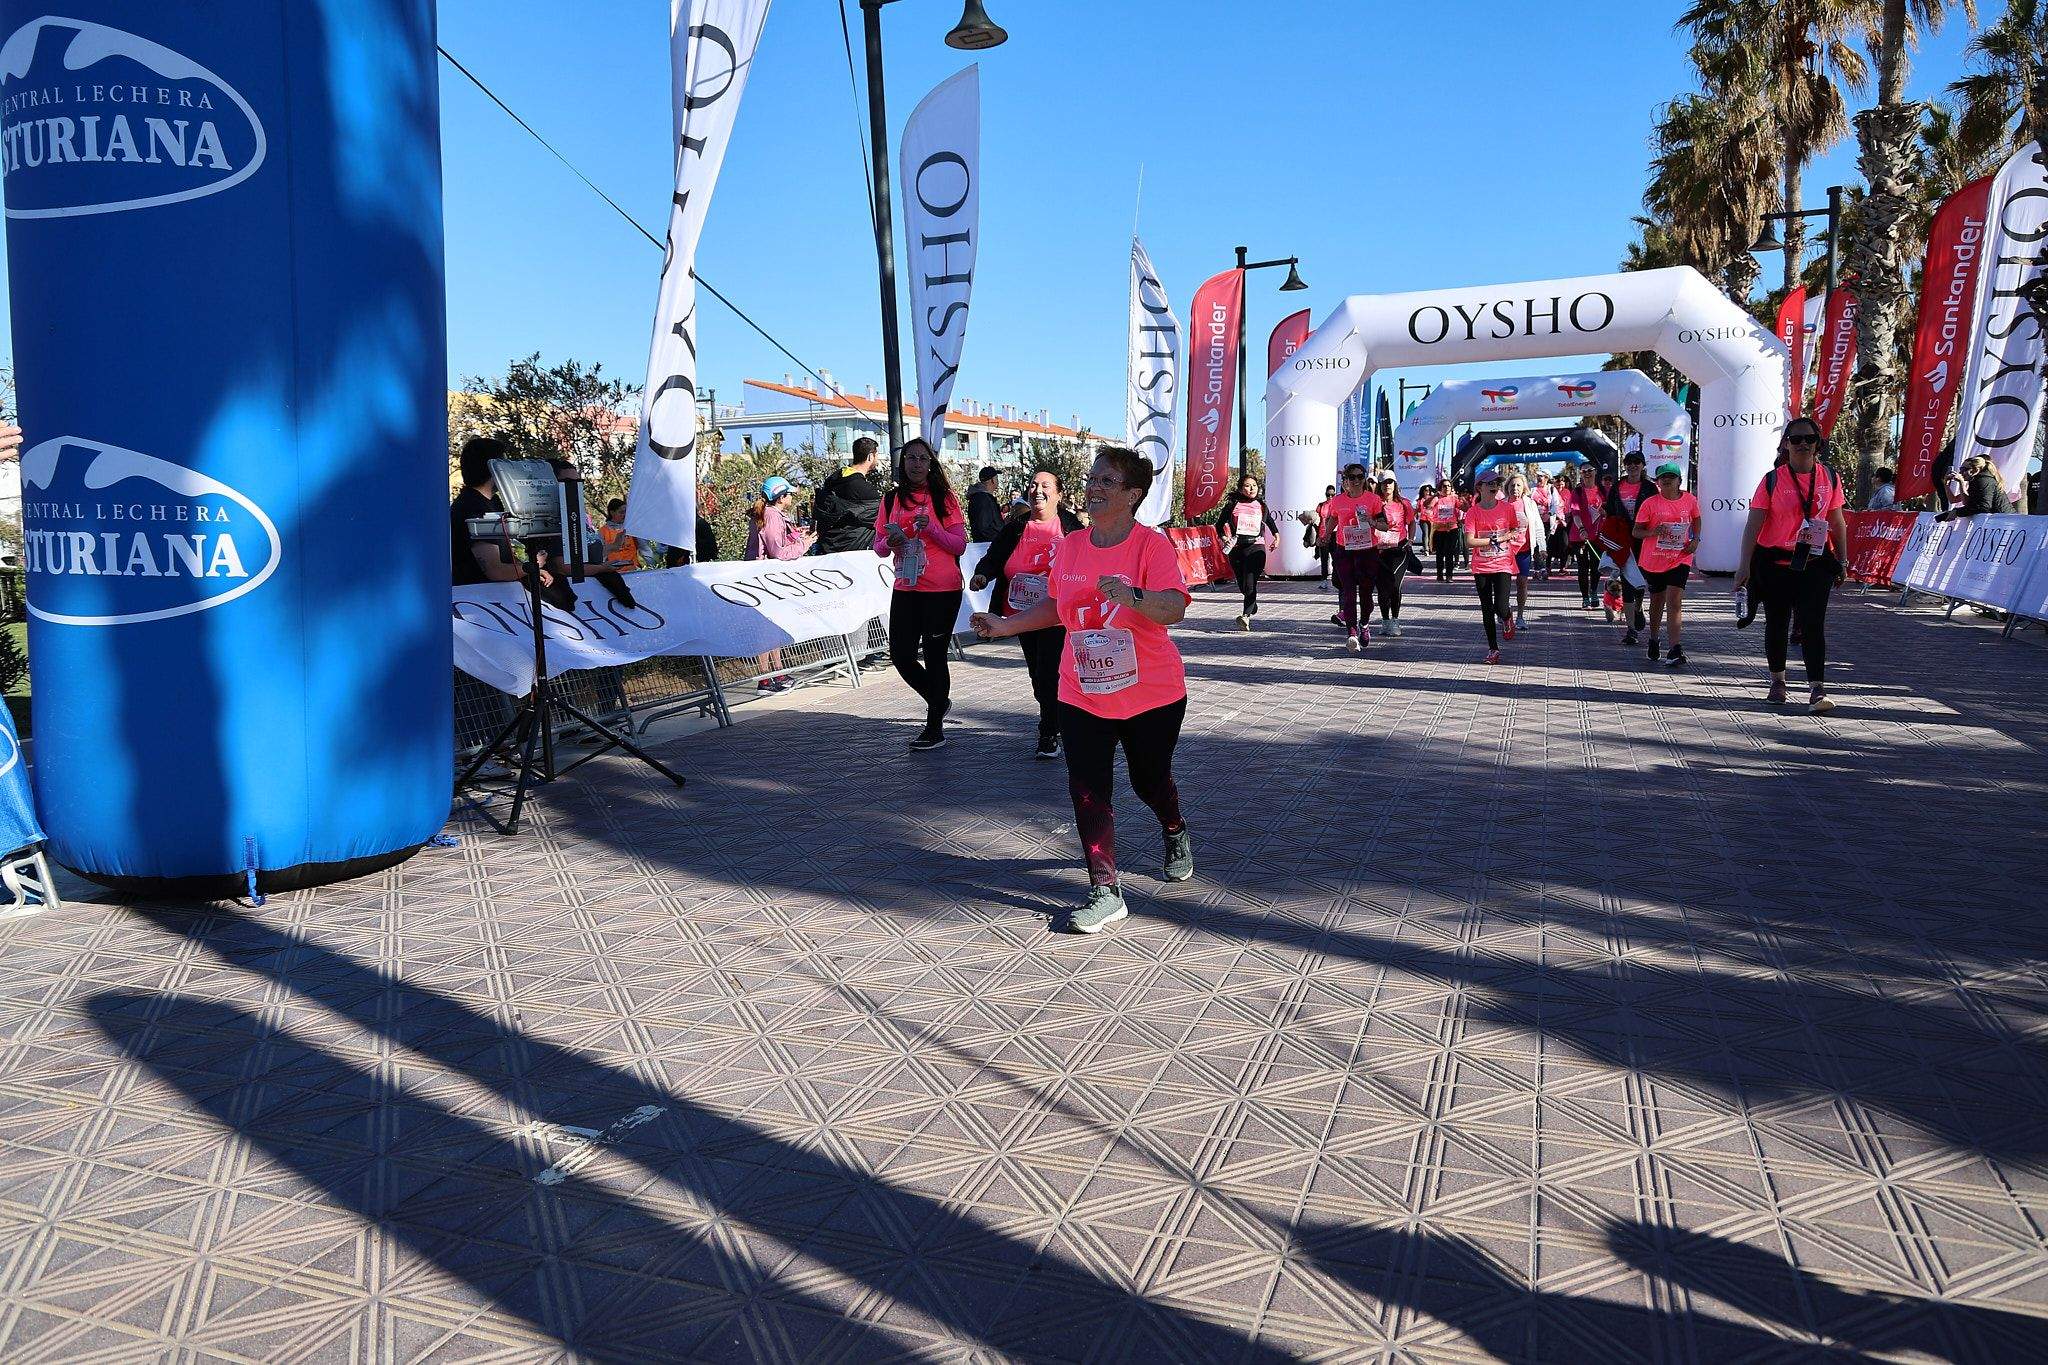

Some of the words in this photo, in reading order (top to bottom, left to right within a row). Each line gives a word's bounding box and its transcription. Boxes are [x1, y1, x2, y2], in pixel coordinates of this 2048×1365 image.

[1, 87, 63, 117] ENTRAL
[76, 85, 214, 110] LECHERA
[1408, 292, 1615, 345] OYSHO
[1678, 326, 1746, 344] OYSHO
[1821, 299, 1858, 395] Santander
[1913, 398, 1940, 479] Sports
[1934, 215, 1983, 356] Santander
[1204, 301, 1227, 405] Santander
[1294, 357, 1350, 372] OYSHO
[1135, 275, 1176, 477] OYSHO
[1558, 400, 1597, 408] TotalEnergies
[1713, 411, 1777, 428] OYSHO
[1270, 434, 1320, 448] OYSHO
[1495, 436, 1572, 446] VOLVO
[1197, 436, 1218, 497] Sports
[24, 503, 84, 519] ENTRAL
[96, 504, 231, 522] LECHERA
[1965, 526, 2027, 566] OYSHO
[710, 569, 854, 608] OYSHO
[1089, 656, 1115, 670] 016
